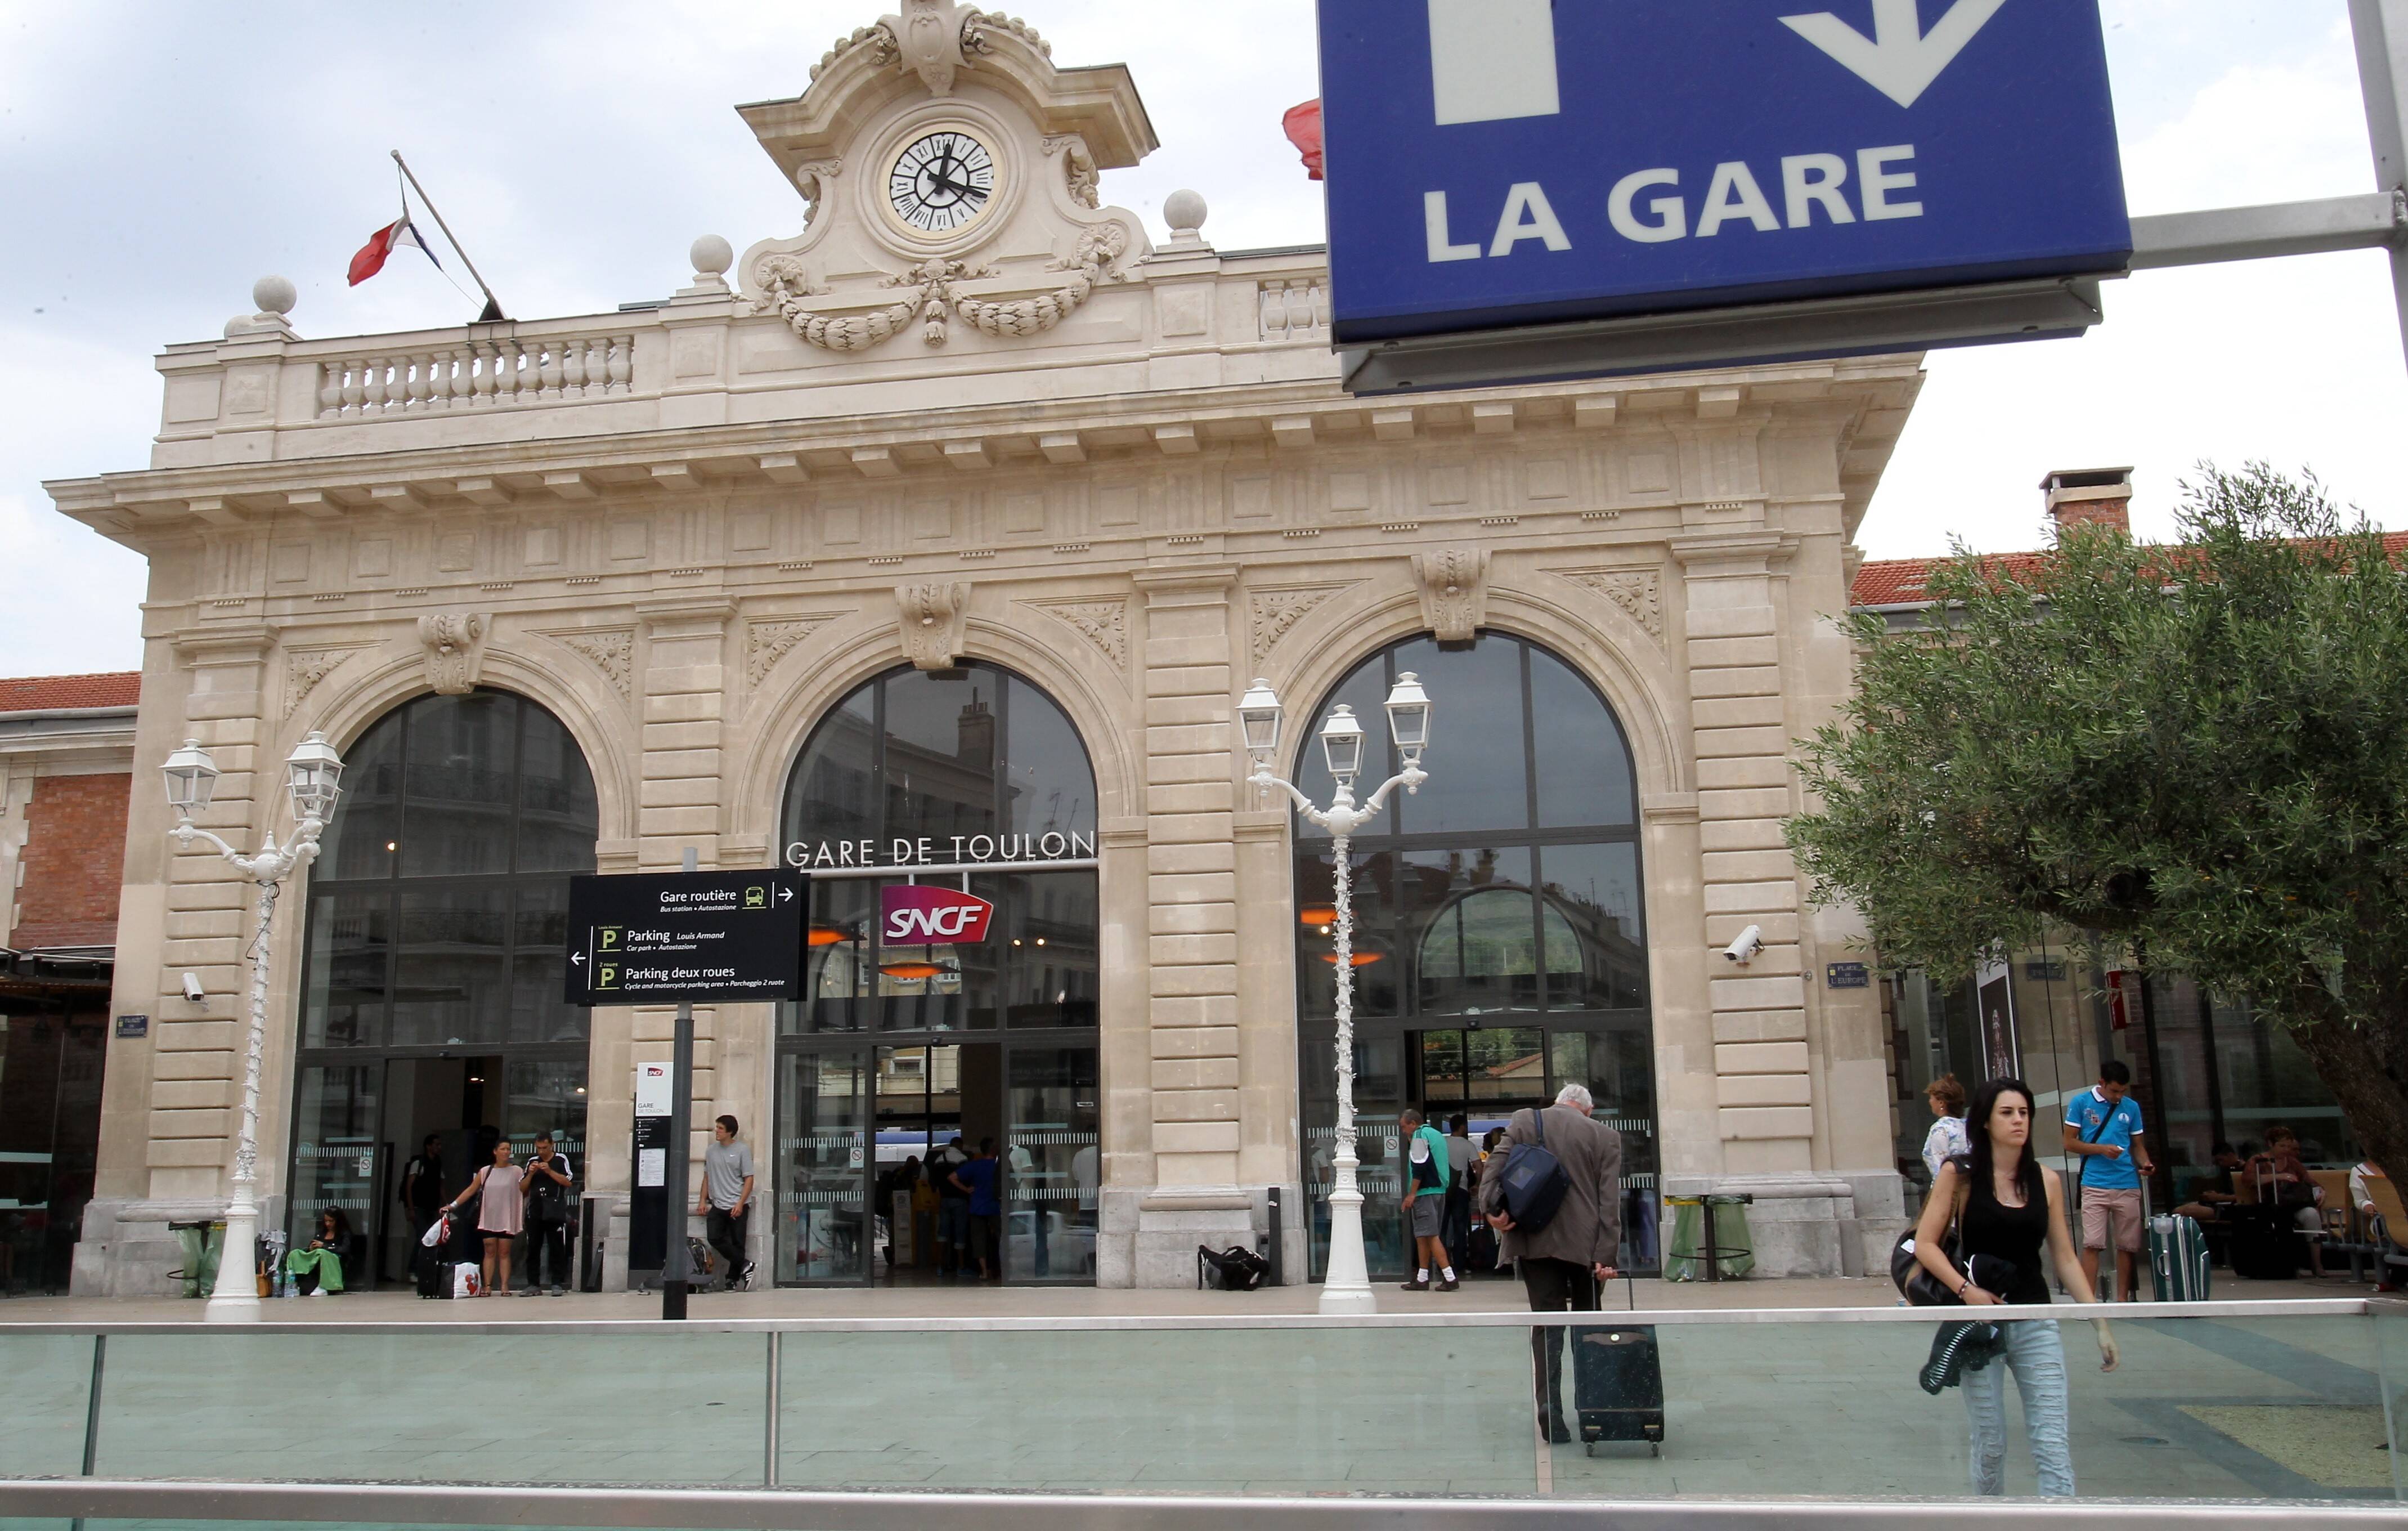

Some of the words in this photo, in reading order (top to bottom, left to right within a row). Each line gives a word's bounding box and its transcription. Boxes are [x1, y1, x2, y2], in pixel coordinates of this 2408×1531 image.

[1424, 182, 1572, 263] LA
[1607, 144, 1924, 244] GARE
[786, 839, 874, 867] GARE
[894, 838, 932, 862] DE
[950, 830, 1095, 860] TOULON
[660, 891, 687, 902] Gare
[690, 889, 737, 901] routière
[886, 905, 983, 938] SNCF
[602, 930, 617, 948] P
[627, 930, 670, 943] Parking
[601, 968, 615, 986] P
[626, 968, 668, 981] Parking
[671, 967, 699, 978] deux
[703, 968, 735, 977] roues
